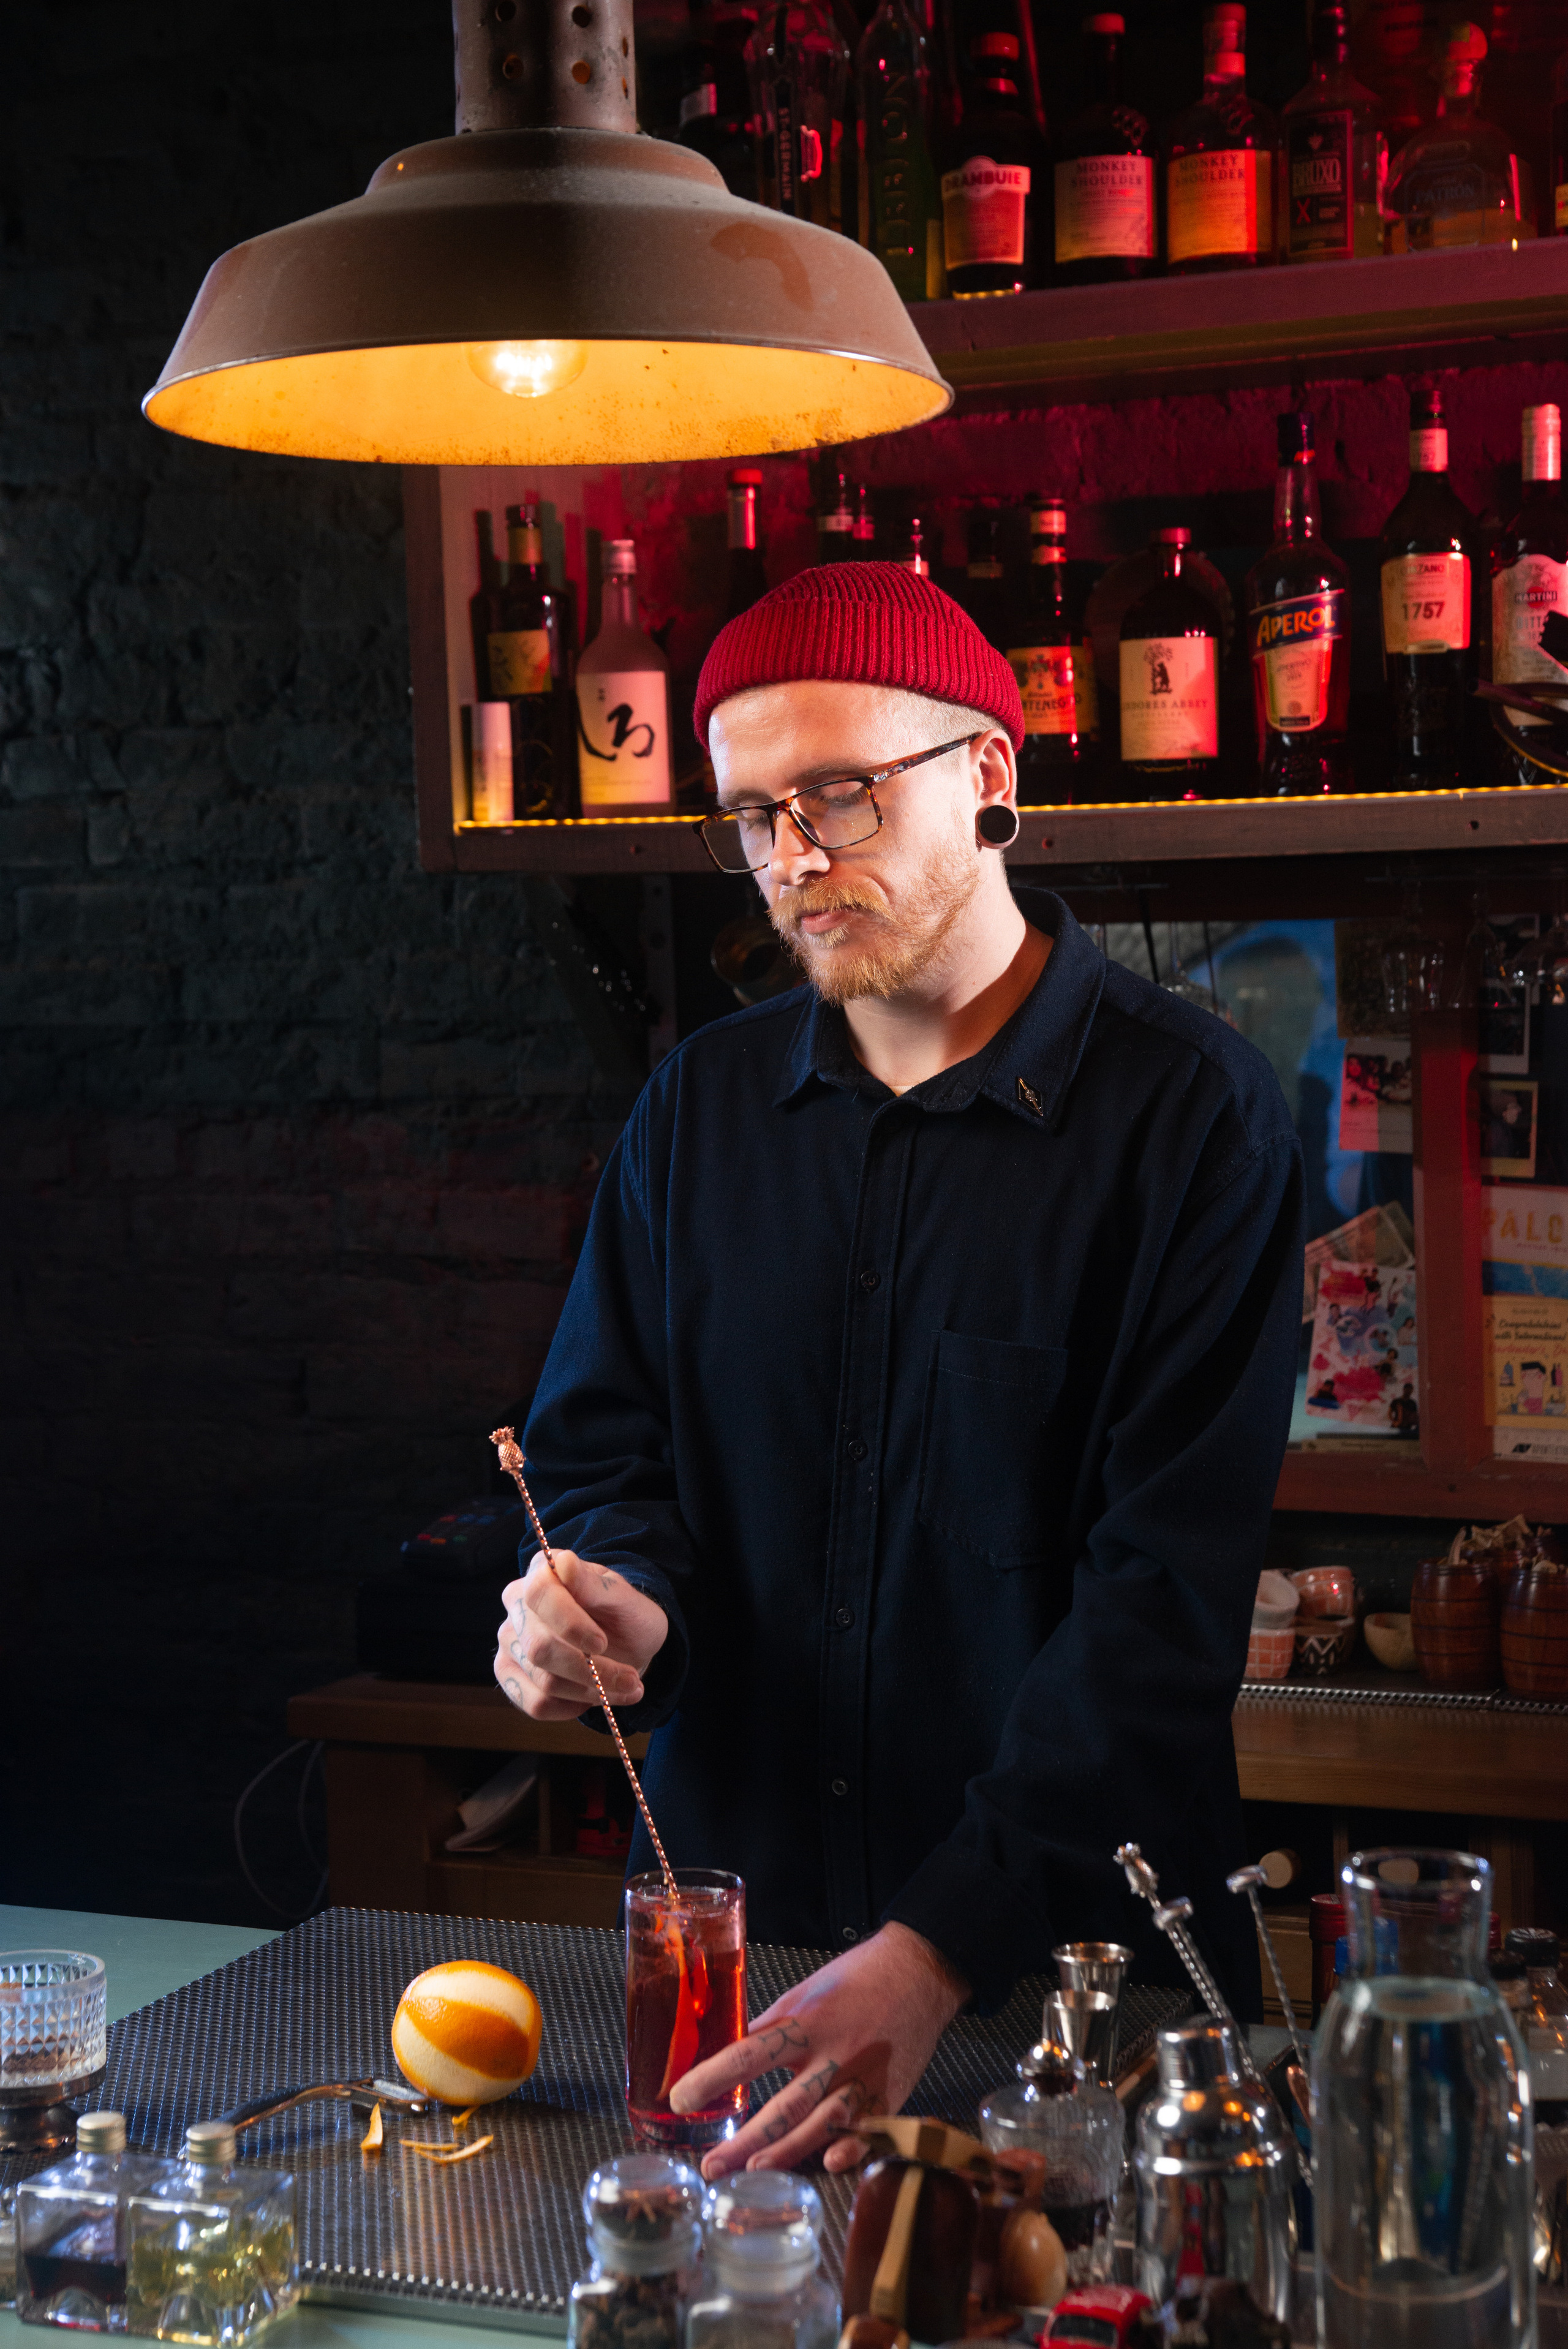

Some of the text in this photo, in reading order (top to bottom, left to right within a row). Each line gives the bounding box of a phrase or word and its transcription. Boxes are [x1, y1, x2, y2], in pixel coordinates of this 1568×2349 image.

[1076, 160, 1136, 173] MONKEY
[1179, 154, 1238, 170] MONKEY
[1292, 157, 1341, 186] BRUXO
[1515, 591, 1558, 605] MARTINI
[1402, 601, 1445, 621] 1757
[1257, 605, 1336, 647] APEROL
